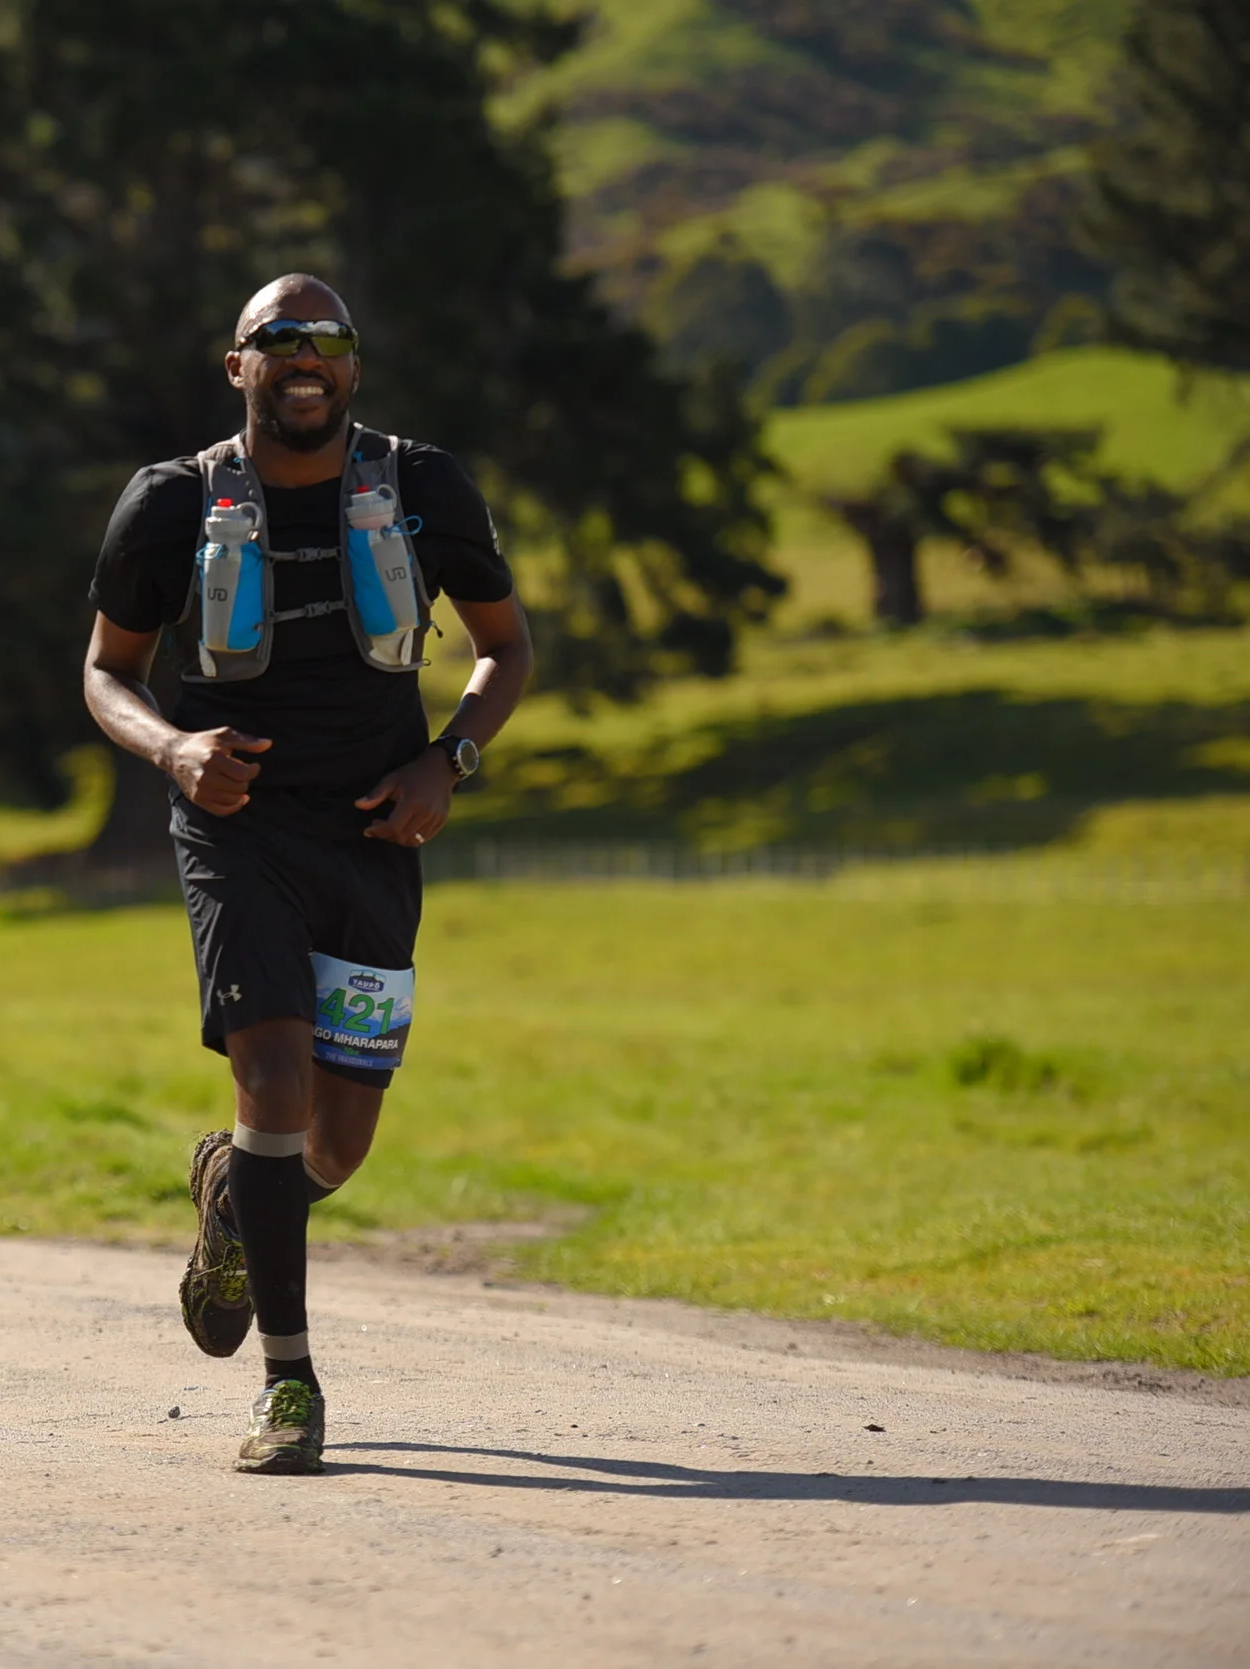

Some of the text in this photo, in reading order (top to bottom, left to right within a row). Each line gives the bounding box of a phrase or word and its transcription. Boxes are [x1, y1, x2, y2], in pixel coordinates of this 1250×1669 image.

[207, 588, 228, 601] UD
[319, 987, 395, 1034] 421
[312, 1026, 398, 1050] GO MHARAPARA
